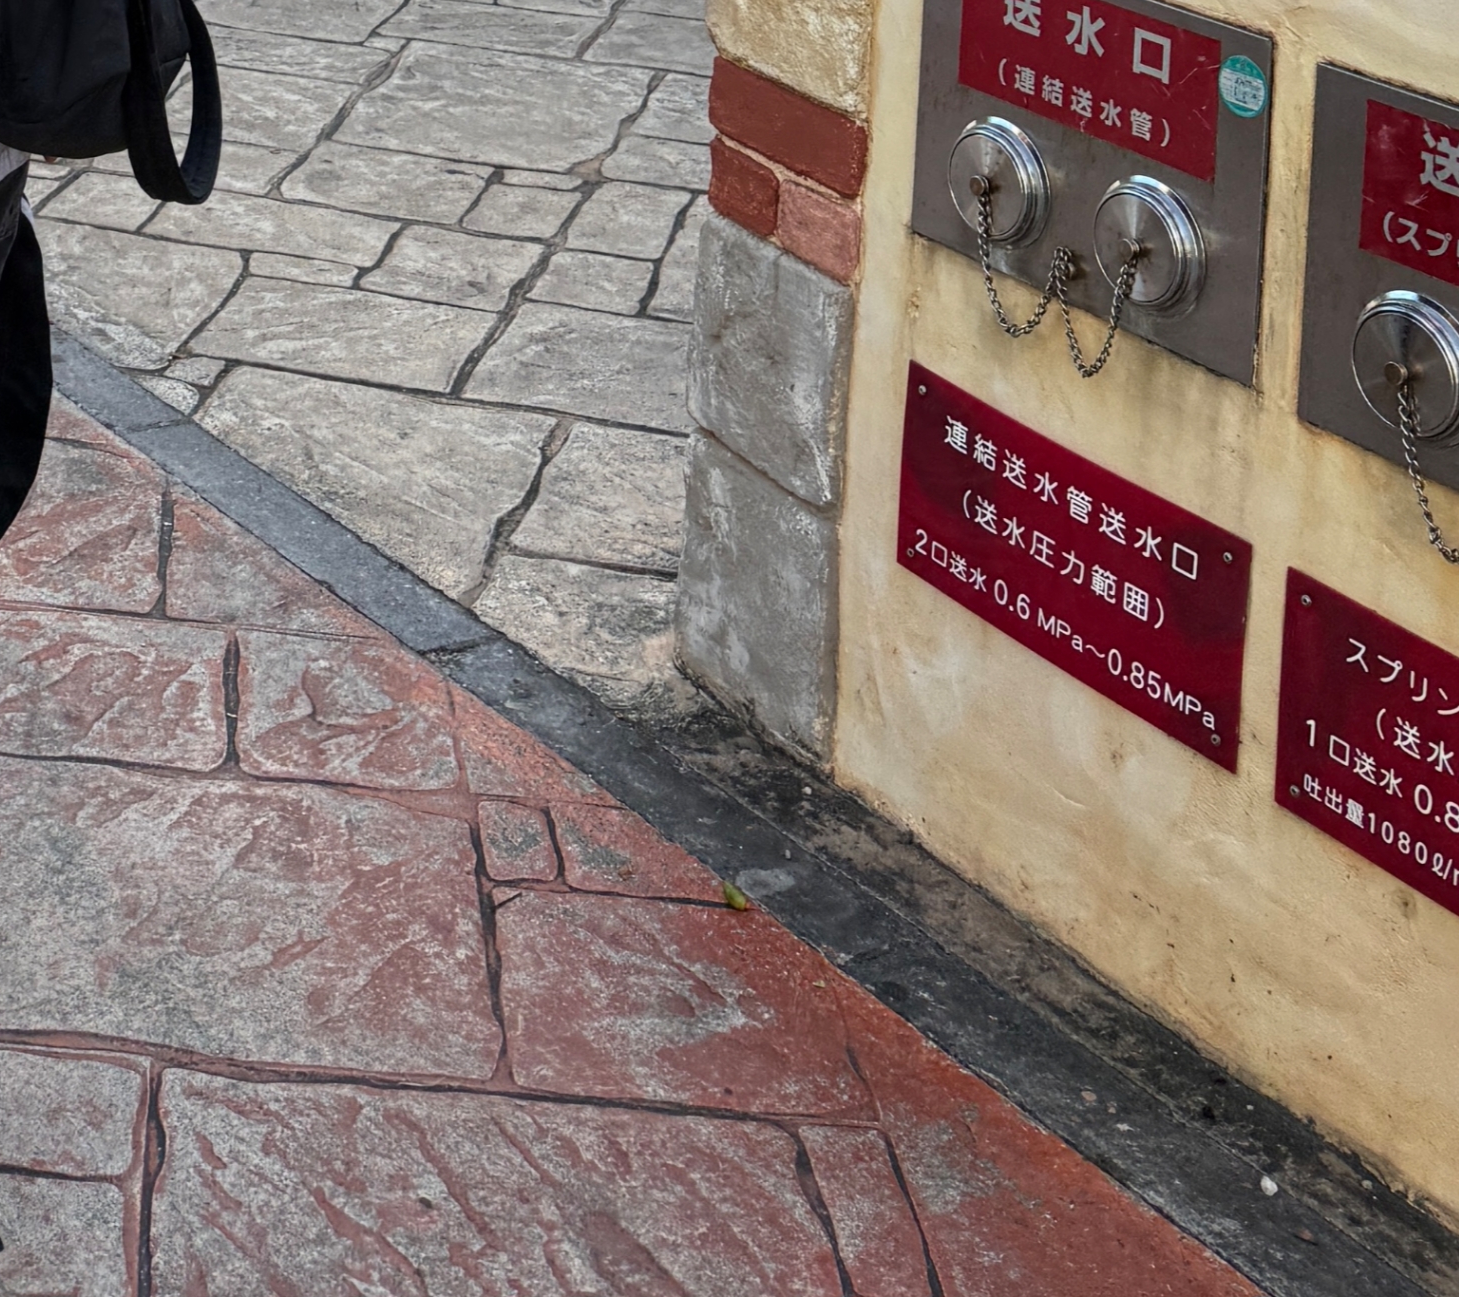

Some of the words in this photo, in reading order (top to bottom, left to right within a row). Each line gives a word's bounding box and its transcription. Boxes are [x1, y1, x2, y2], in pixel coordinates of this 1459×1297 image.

[943, 414, 1199, 581] 連結送水管送水口
